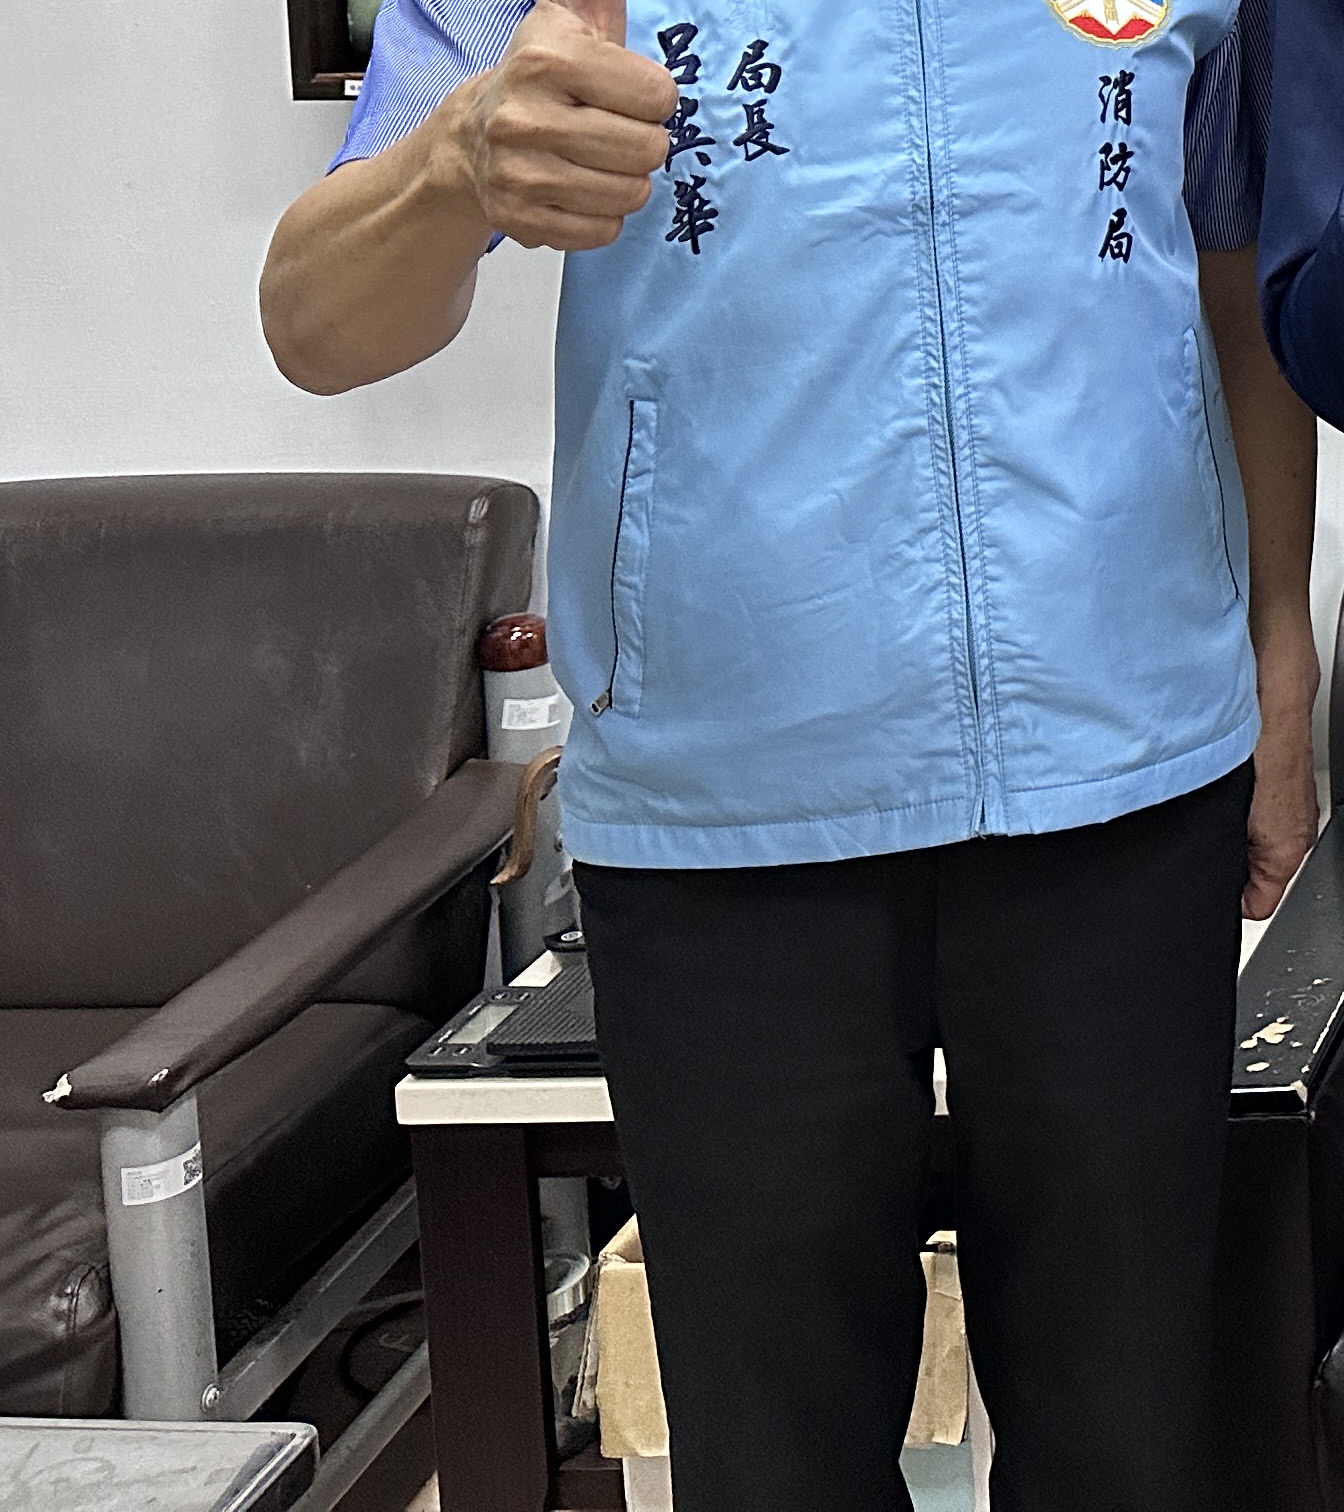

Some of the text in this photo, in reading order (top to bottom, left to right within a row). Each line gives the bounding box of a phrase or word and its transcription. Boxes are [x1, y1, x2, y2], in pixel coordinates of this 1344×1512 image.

[727, 39, 791, 162] 局長
[1098, 70, 1135, 265] 消防局
